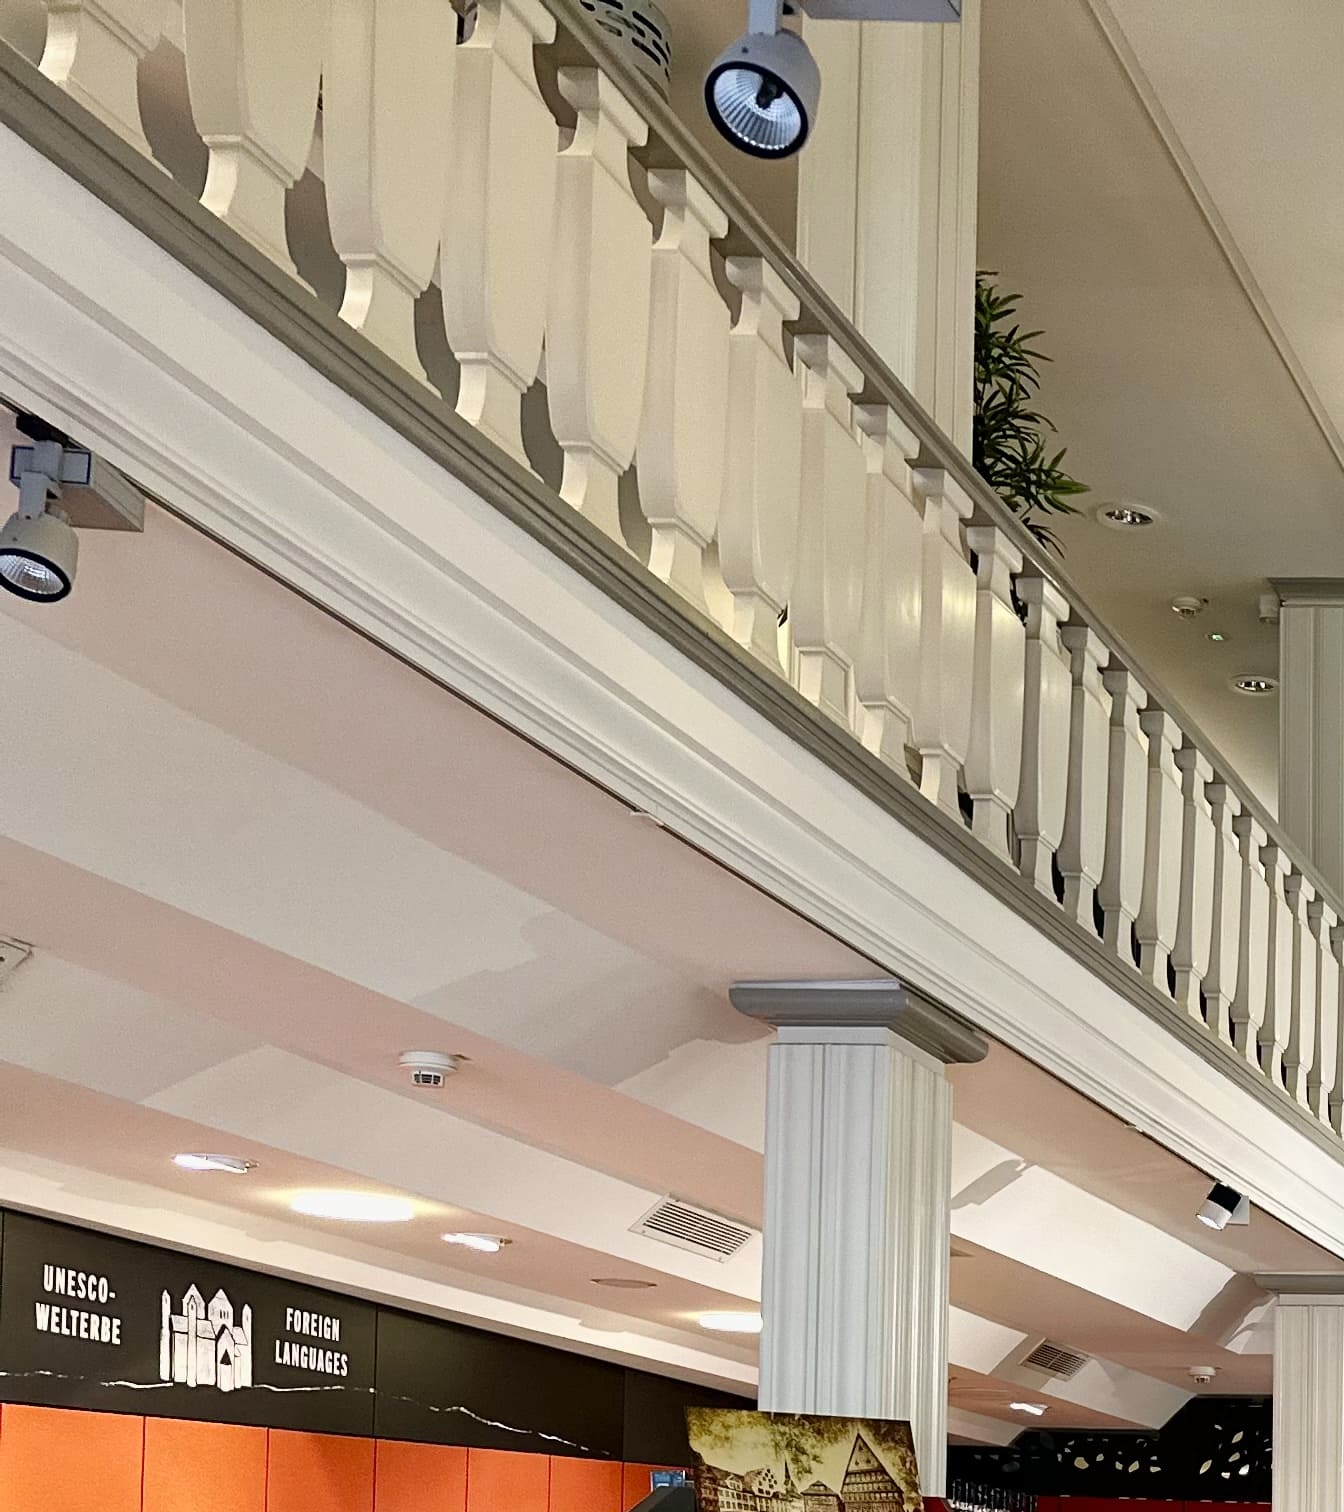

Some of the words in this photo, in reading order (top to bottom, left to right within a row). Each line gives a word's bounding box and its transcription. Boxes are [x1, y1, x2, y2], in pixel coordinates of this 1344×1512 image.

[43, 1264, 117, 1304] UNESCO-
[35, 1302, 122, 1345] WELTERBE
[285, 1307, 341, 1342] FOREIGN
[274, 1339, 349, 1377] LANGUAGES
